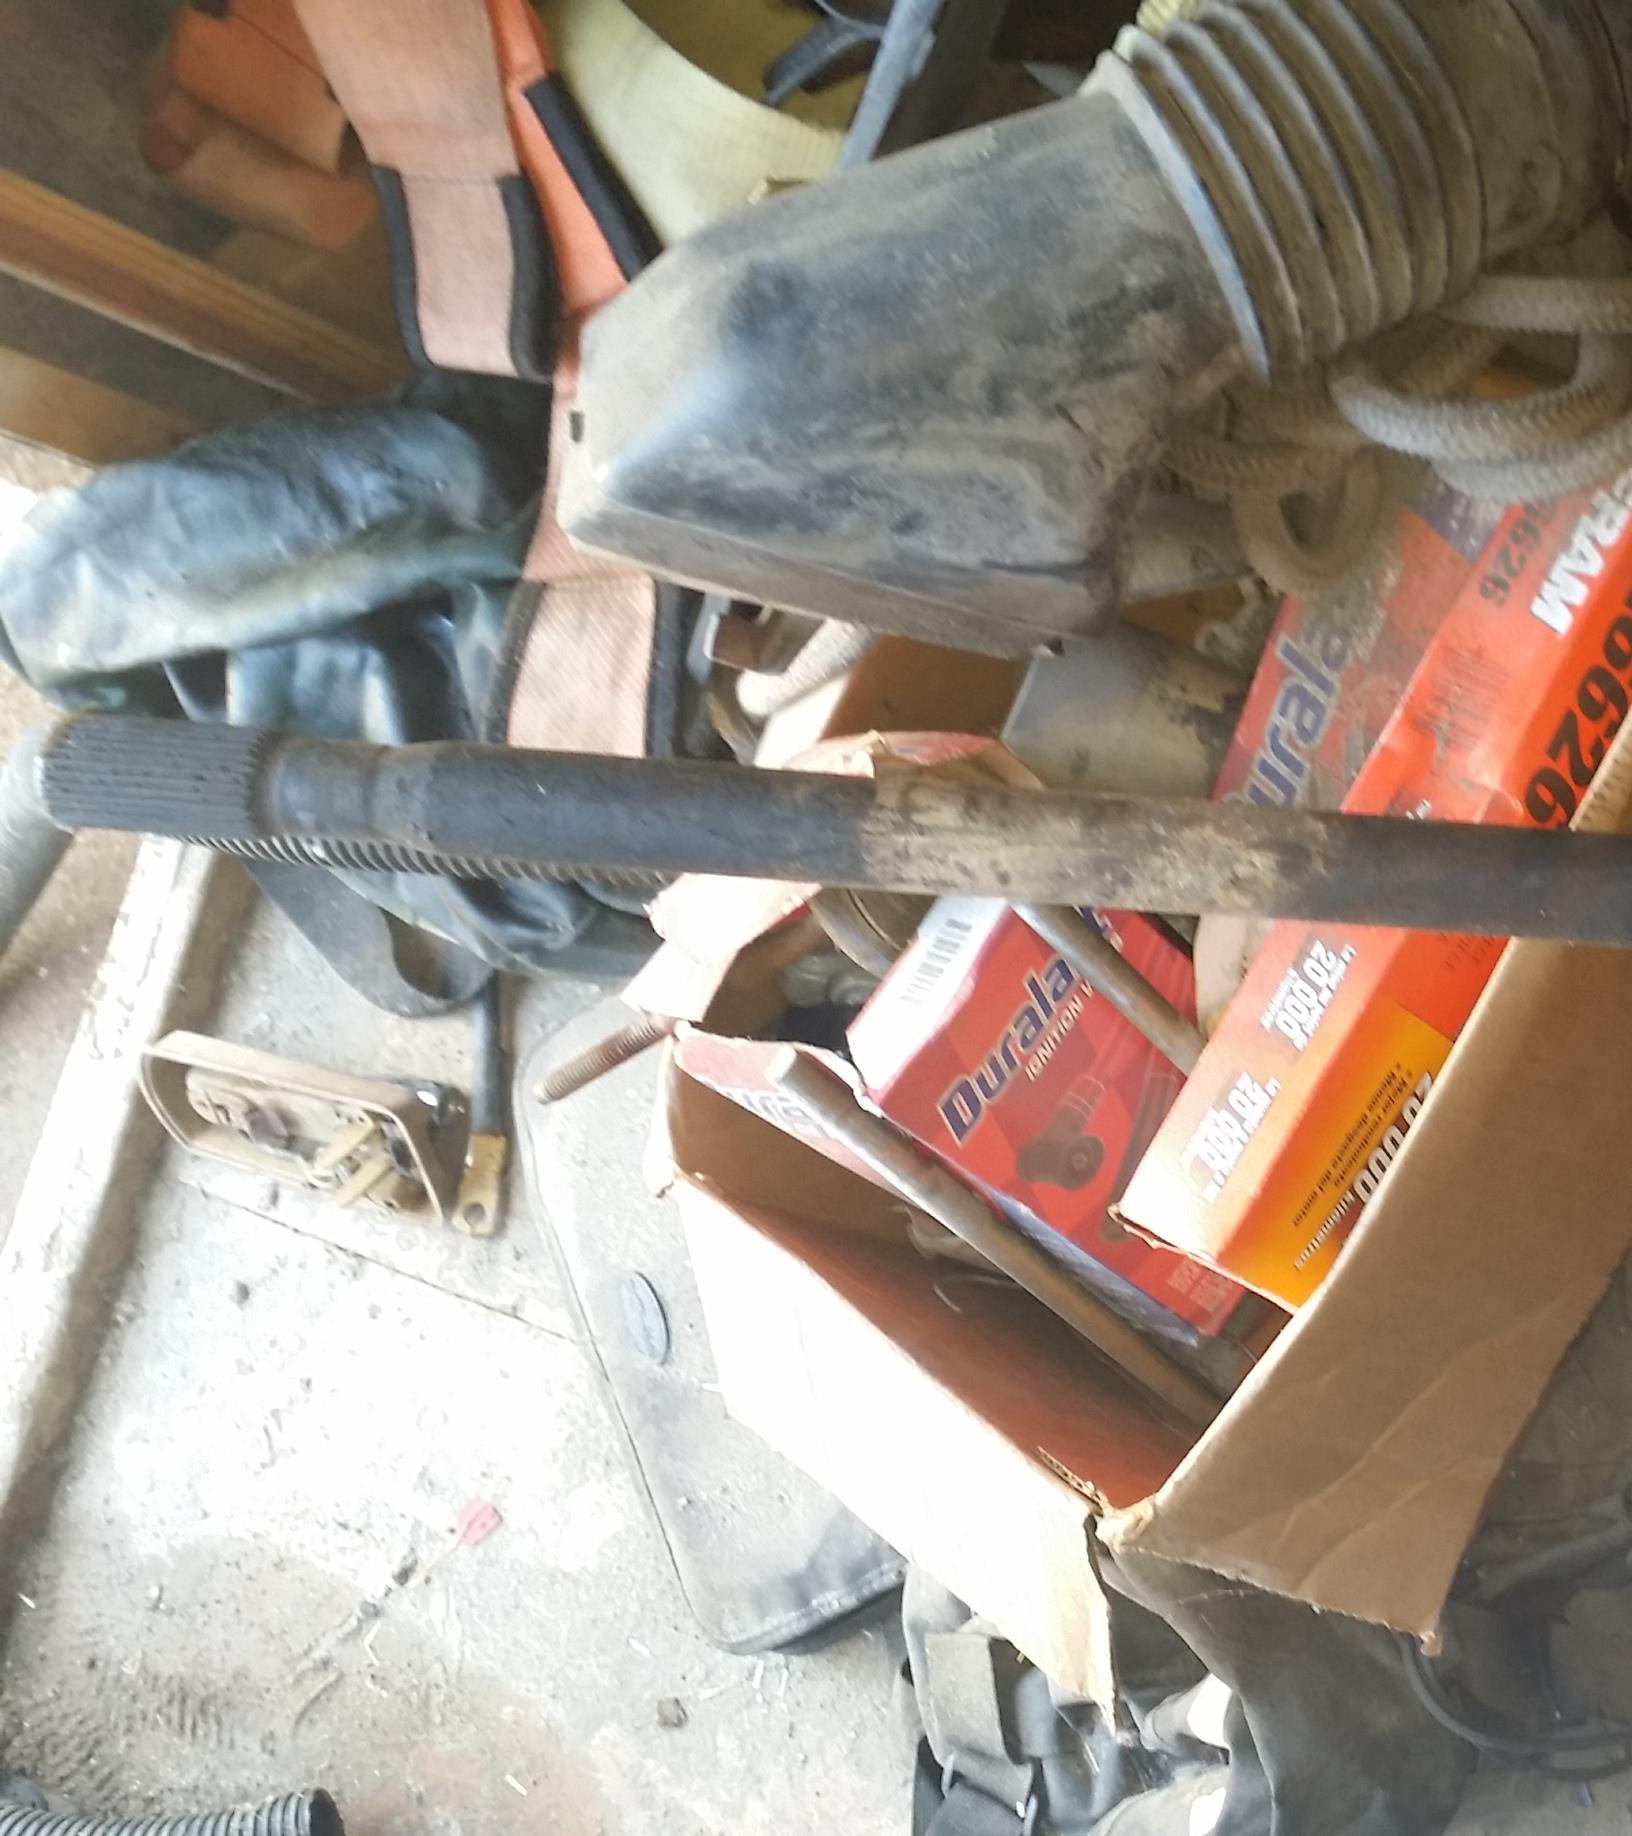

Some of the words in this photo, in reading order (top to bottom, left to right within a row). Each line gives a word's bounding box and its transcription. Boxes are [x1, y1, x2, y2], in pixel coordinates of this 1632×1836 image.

[1301, 939, 1339, 988] 20
[1273, 977, 1319, 1041] 000
[1024, 997, 1086, 1083] IGNITION
[1226, 1070, 1265, 1121] 20
